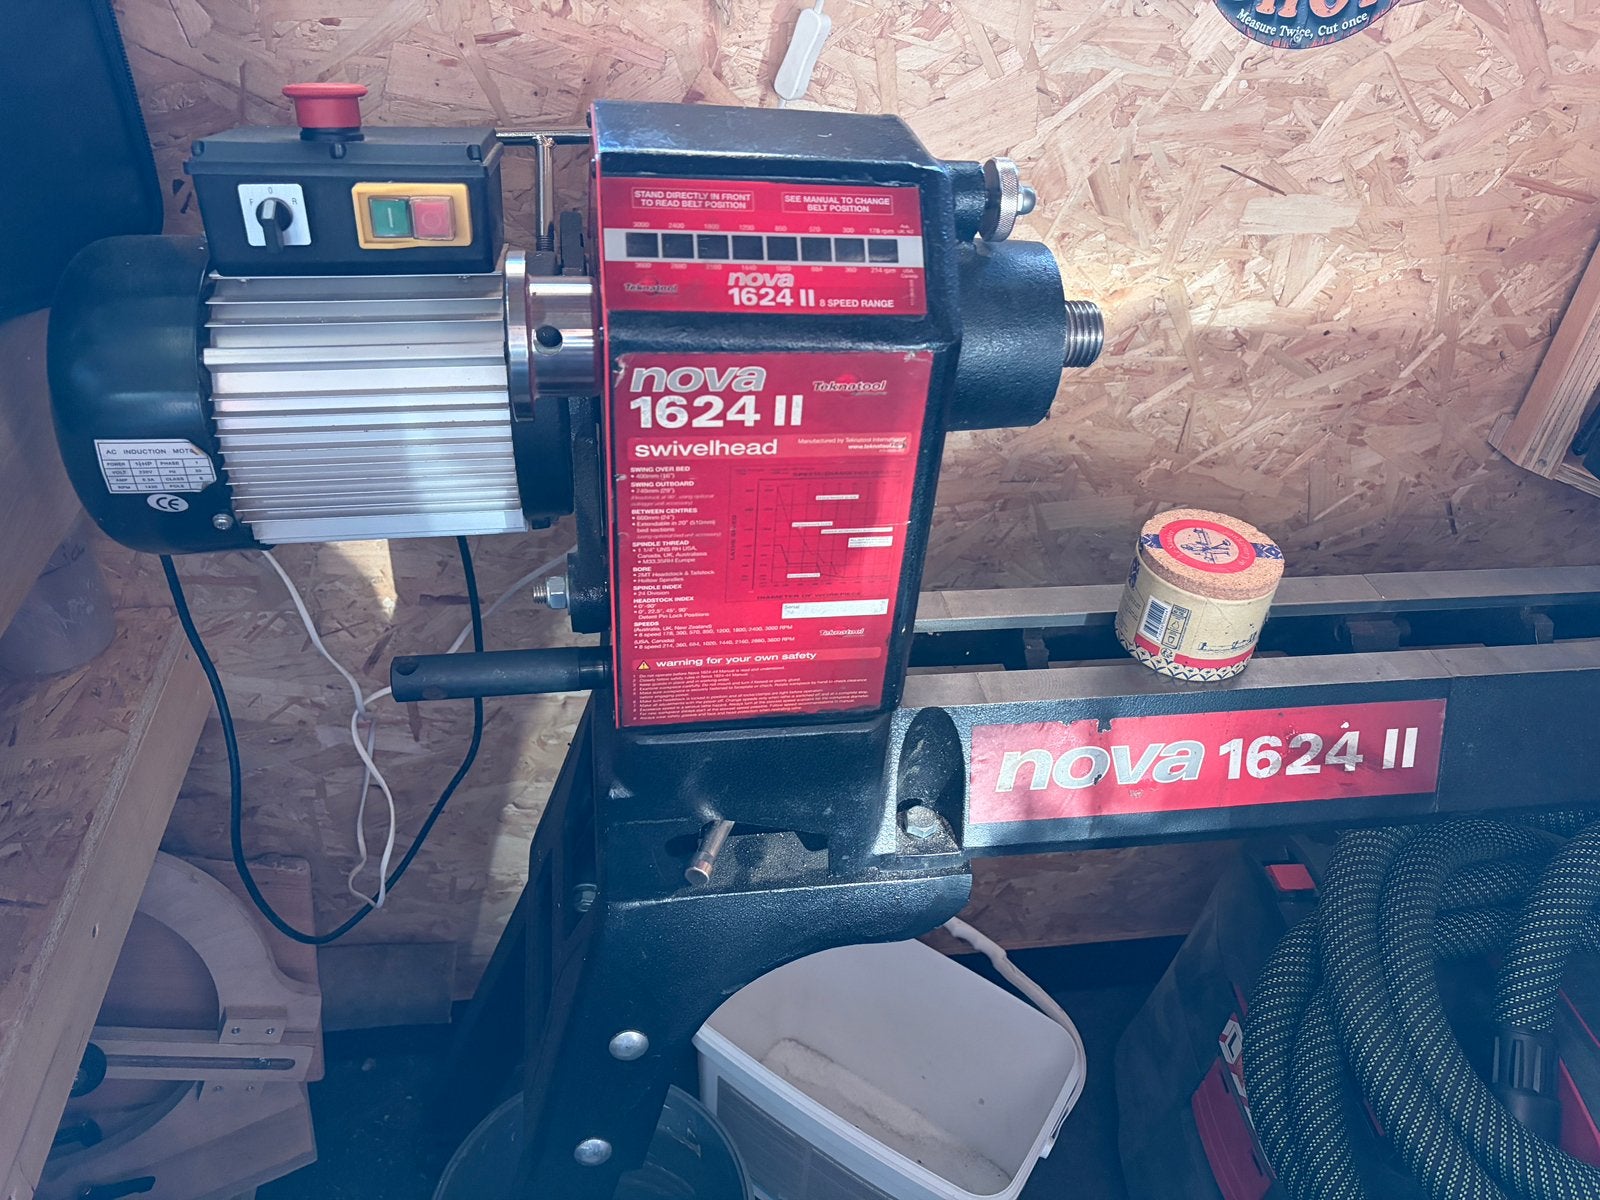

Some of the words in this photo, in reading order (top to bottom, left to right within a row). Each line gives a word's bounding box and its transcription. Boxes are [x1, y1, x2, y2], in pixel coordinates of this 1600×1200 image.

[1236, 8, 1276, 36] Measure
[1279, 26, 1314, 40] Twice,
[1318, 24, 1338, 36] Cut
[1341, 12, 1368, 30] once
[666, 191, 708, 200] DIRECTLY
[803, 196, 838, 204] MANUAL
[727, 272, 795, 287] nova
[728, 288, 794, 306] 1624
[800, 289, 815, 307] II
[819, 299, 826, 307] 8
[827, 299, 859, 307] SPEED
[861, 300, 894, 308] RANGE
[629, 366, 767, 393] nova
[812, 380, 887, 392] Teknatool
[630, 395, 761, 428] 1624
[774, 395, 803, 426] II
[634, 439, 778, 457] swivelhead
[656, 659, 703, 668] warning
[995, 740, 1206, 793] nova
[1218, 730, 1363, 780] 1624
[1382, 728, 1418, 770] II
